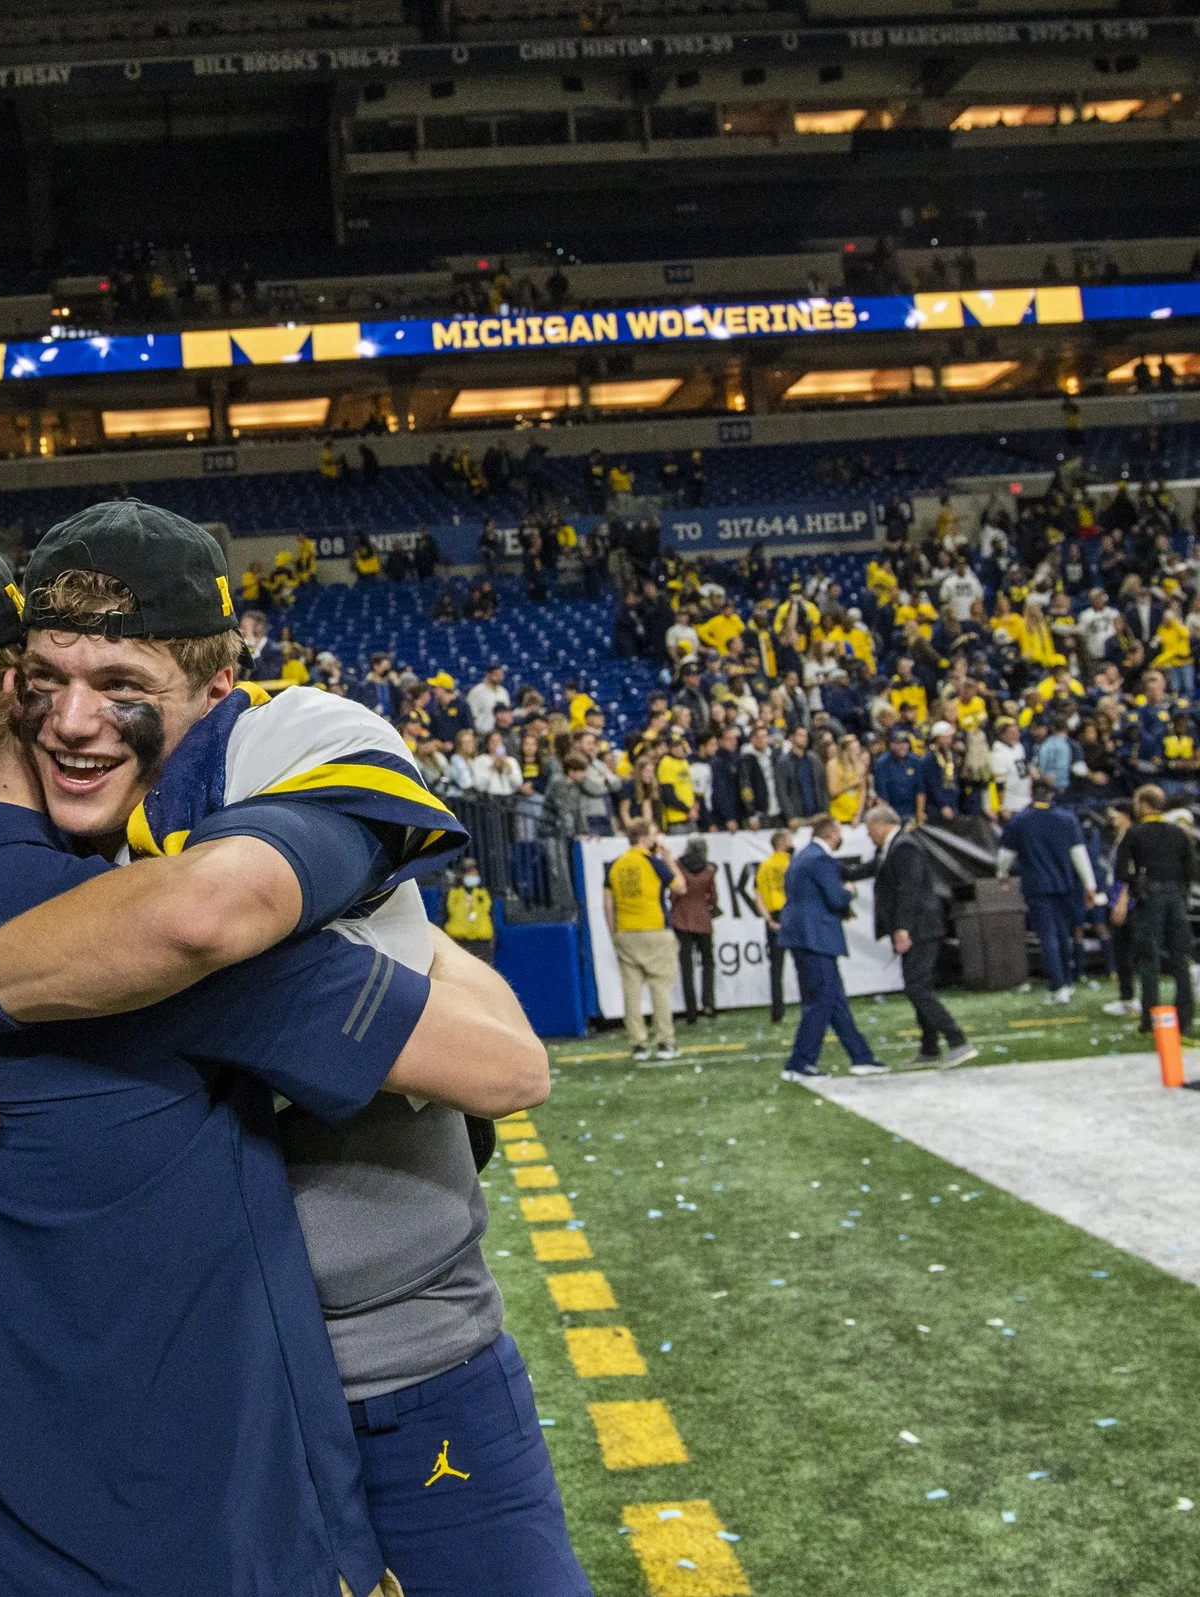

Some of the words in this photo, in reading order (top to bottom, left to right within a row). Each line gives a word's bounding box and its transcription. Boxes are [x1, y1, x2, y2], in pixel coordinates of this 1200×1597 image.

[519, 38, 577, 60] CHRIS
[580, 35, 652, 58] HINTON
[194, 55, 239, 75] BILL
[242, 51, 318, 72] BROOKS
[12, 64, 71, 87] IRSAY
[432, 313, 618, 350] MICHIGAN
[625, 300, 857, 340] WOLVERINES
[672, 521, 702, 541] TO
